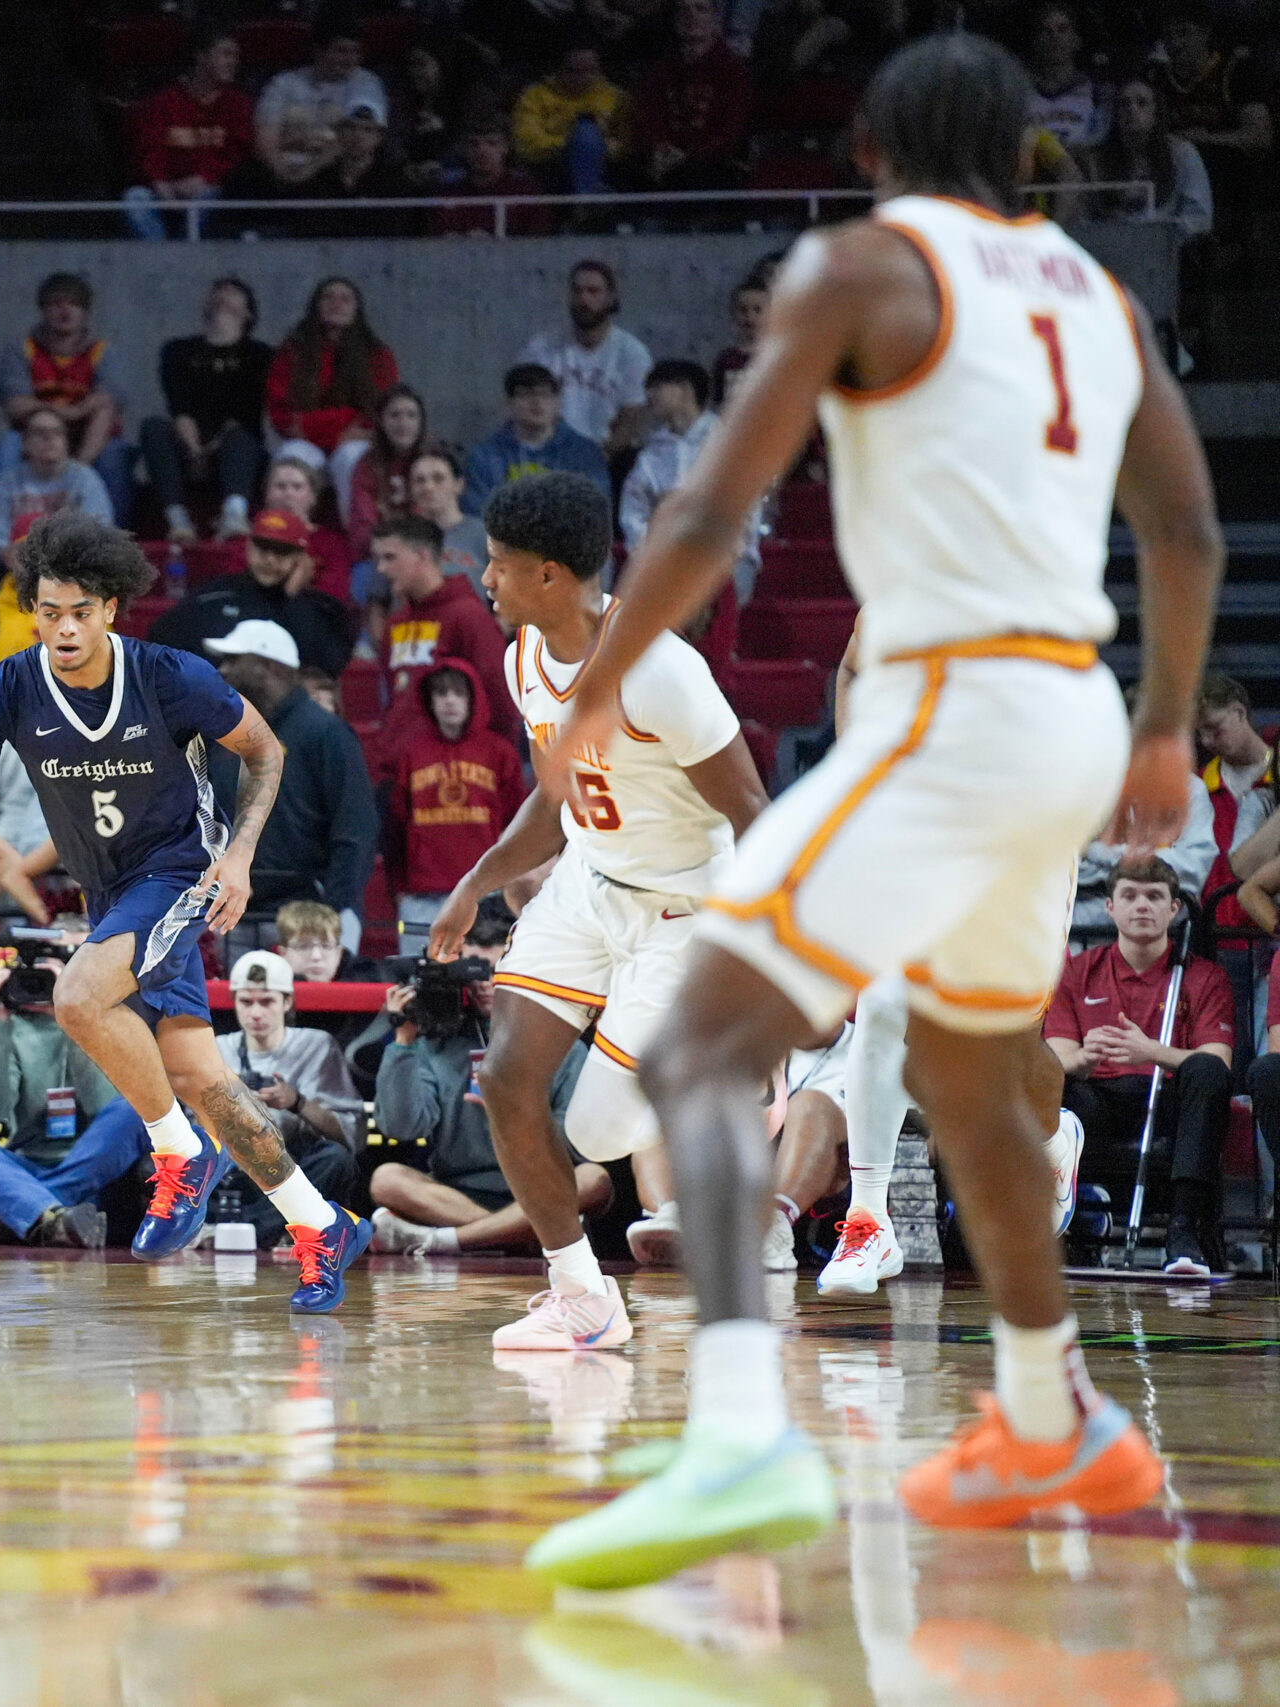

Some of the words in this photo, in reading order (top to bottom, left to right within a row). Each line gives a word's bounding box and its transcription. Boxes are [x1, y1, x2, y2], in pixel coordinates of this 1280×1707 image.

[1029, 312, 1080, 455] 1
[41, 758, 154, 782] Creighton
[91, 790, 125, 838] 5
